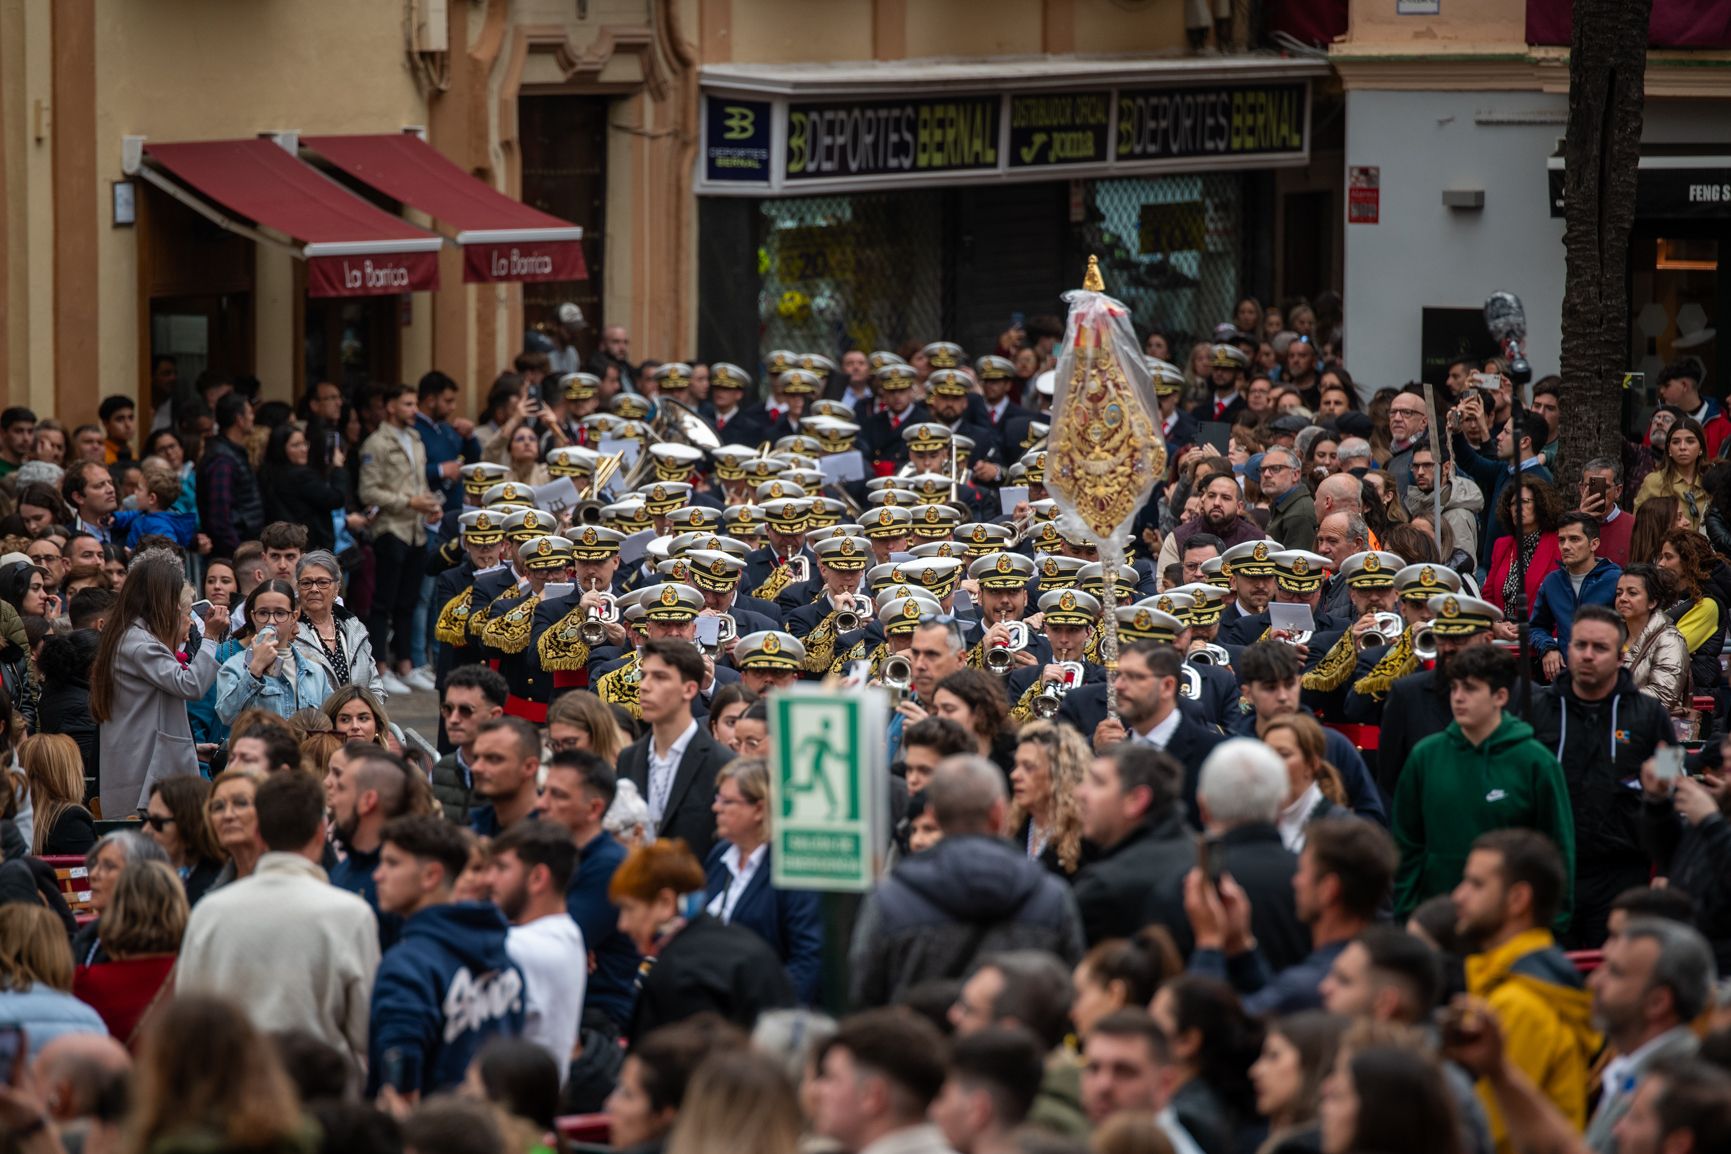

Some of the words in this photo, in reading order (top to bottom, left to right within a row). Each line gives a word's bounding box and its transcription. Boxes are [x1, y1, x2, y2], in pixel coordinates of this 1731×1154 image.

[1132, 91, 1229, 154] DEPORTES
[1231, 90, 1301, 150] BERNAL
[805, 105, 915, 172] DEPORTES
[916, 102, 996, 168] BERNAL
[709, 147, 768, 159] DEPORTES
[715, 157, 761, 168] BERNAL
[1689, 184, 1720, 202] FENG
[344, 260, 361, 288] La
[491, 250, 508, 276] La
